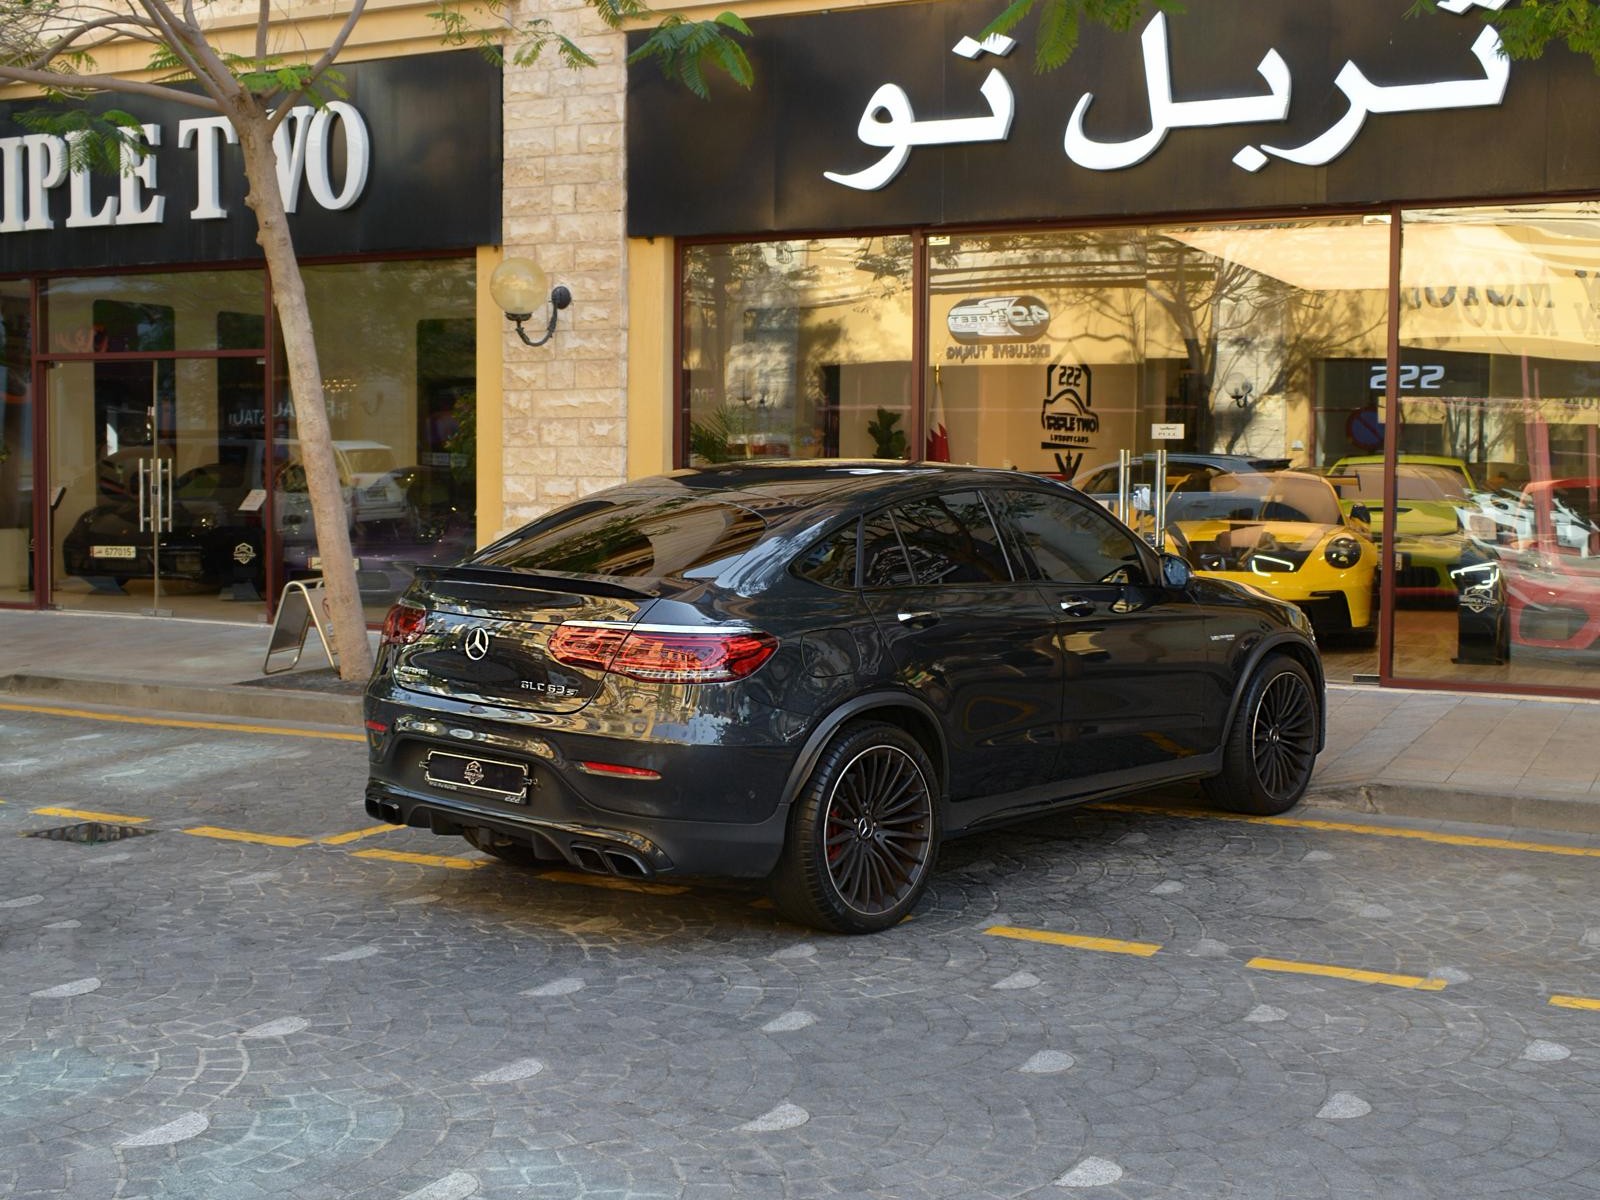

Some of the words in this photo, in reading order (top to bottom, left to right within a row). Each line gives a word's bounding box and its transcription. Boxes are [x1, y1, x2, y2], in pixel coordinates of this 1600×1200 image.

[823, 32, 1017, 191] تو
[1058, 365, 1083, 388] 222
[1370, 365, 1445, 389] 222
[1045, 415, 1076, 432] TRIPLE
[1076, 417, 1097, 433] TWO
[104, 547, 133, 556] 677015
[520, 680, 546, 691] GLC
[547, 684, 565, 694] 63
